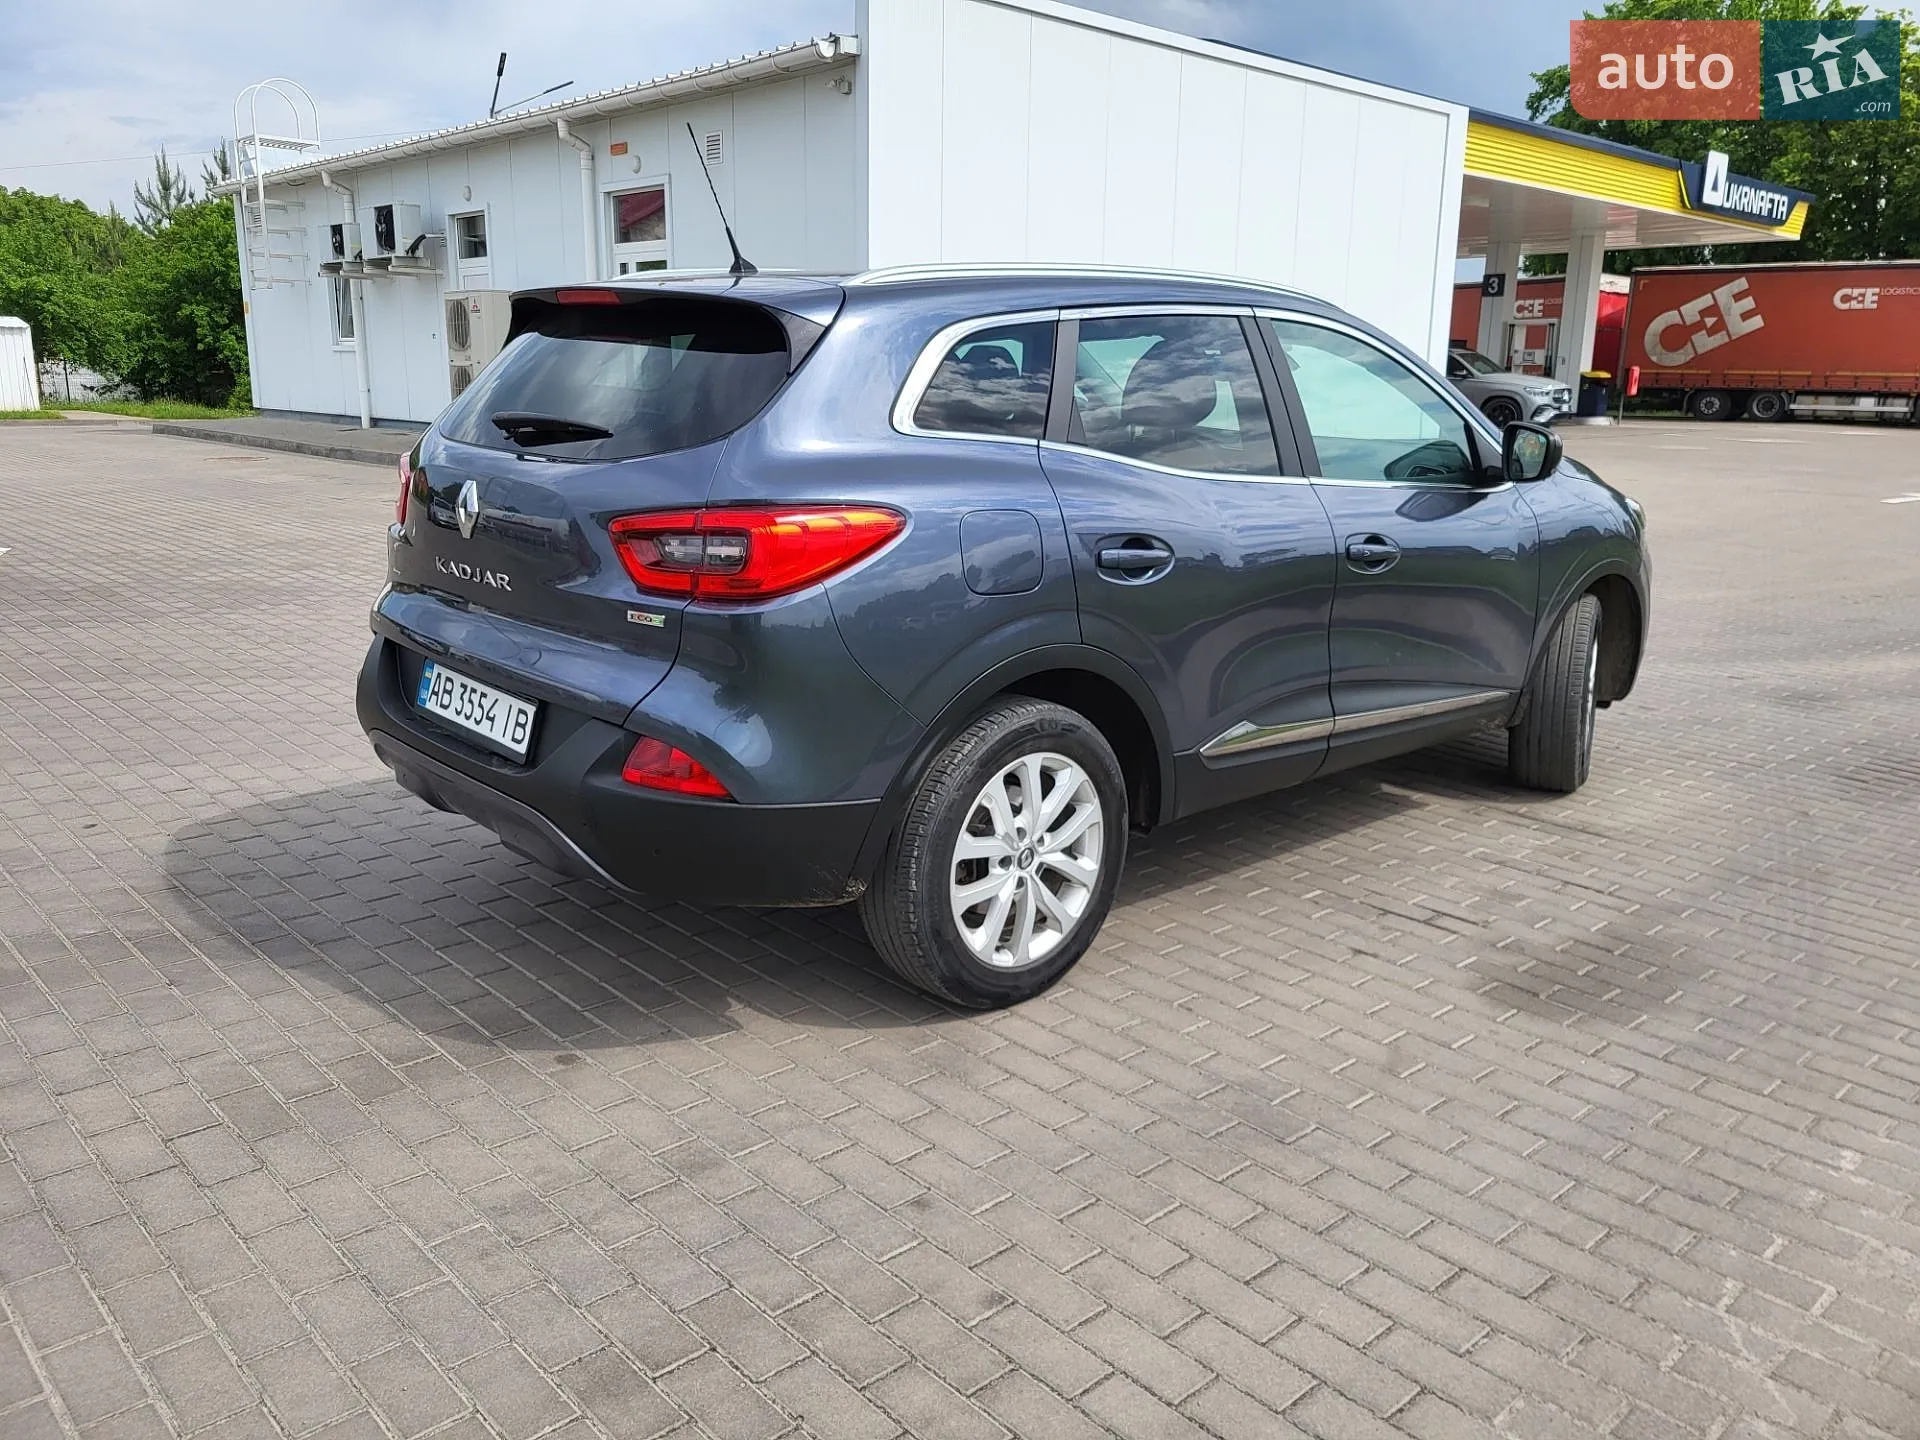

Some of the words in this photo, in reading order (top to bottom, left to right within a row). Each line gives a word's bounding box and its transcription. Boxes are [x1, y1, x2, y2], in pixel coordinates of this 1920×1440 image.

[1723, 181, 1788, 220] UKRNAFTA
[1488, 277, 1499, 294] 3
[1833, 288, 1880, 310] CEE
[1514, 299, 1545, 319] CEE
[1643, 276, 1765, 367] CEE
[435, 555, 512, 592] KADJAR
